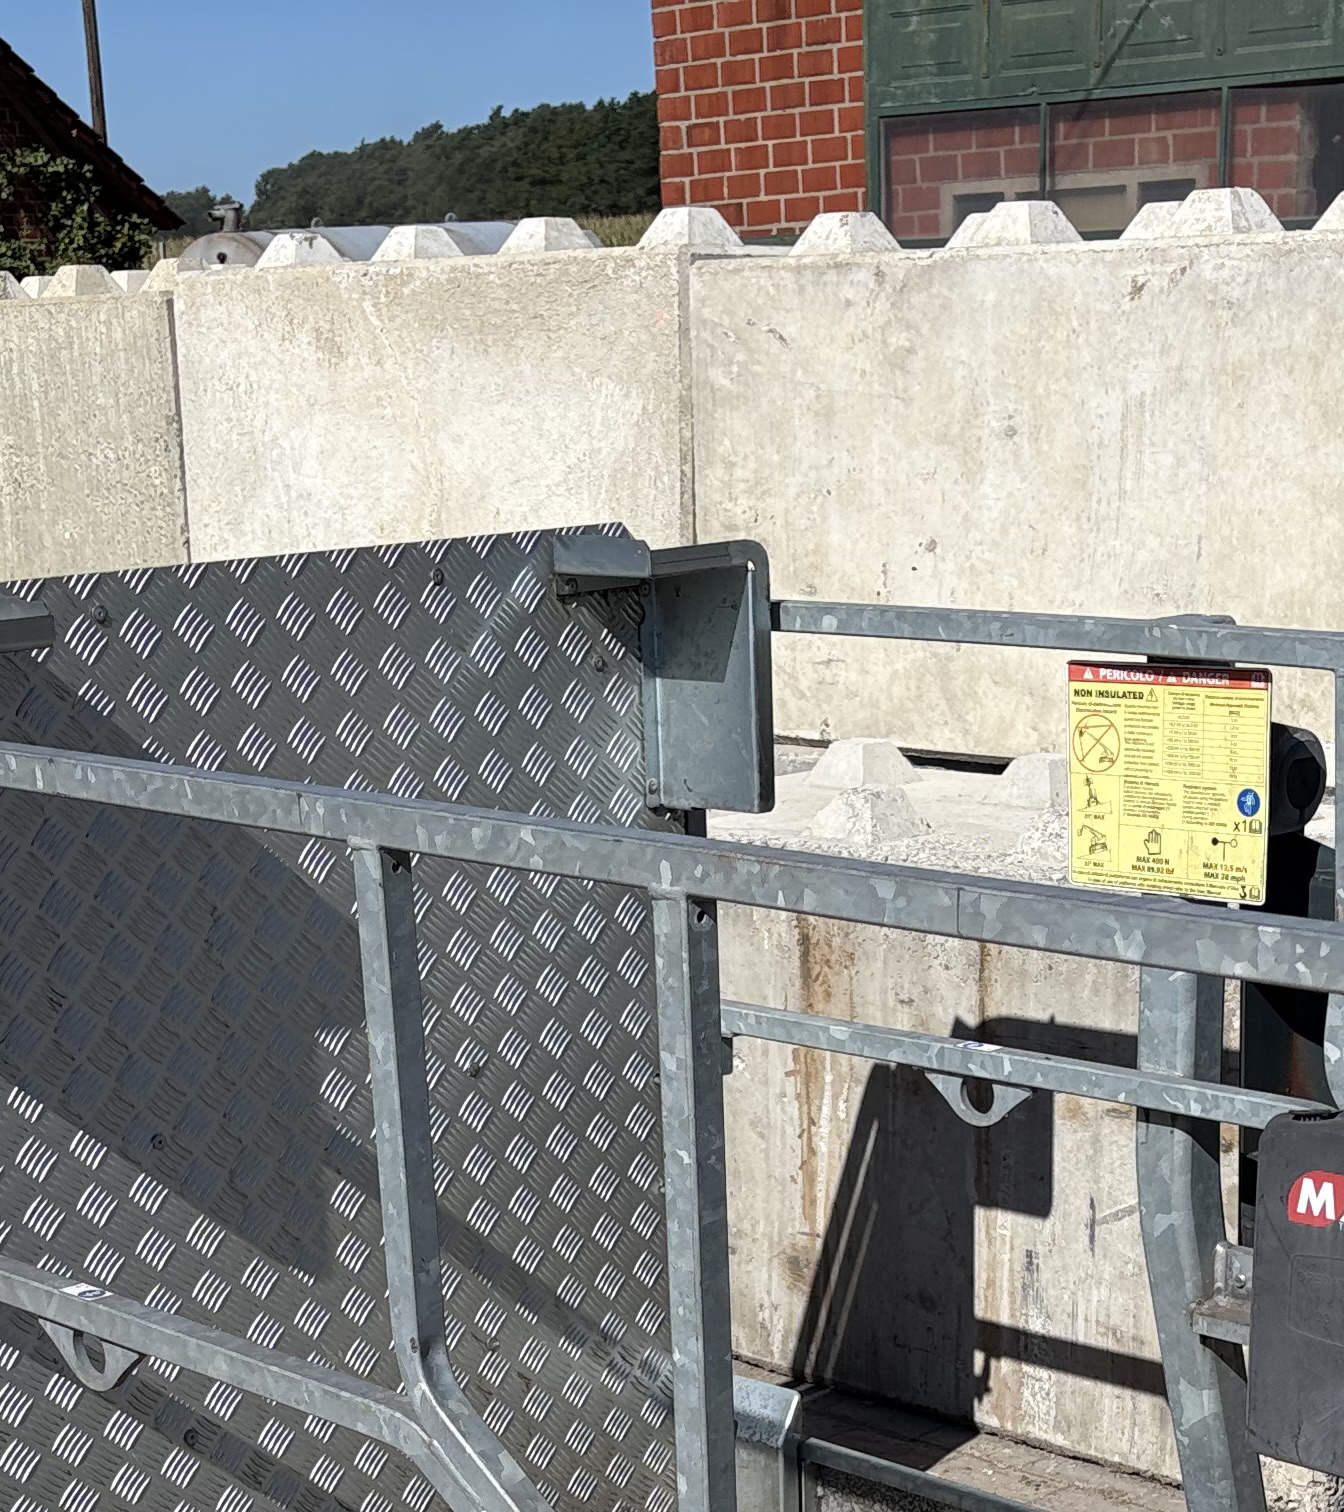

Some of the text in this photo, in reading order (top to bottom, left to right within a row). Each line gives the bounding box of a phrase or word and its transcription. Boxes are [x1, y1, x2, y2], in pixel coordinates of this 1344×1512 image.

[1099, 668, 1155, 681] PERICOLO
[1182, 671, 1230, 685] DANGER
[1074, 688, 1144, 700] NON INSULATED
[1131, 864, 1145, 872] MAX
[1203, 862, 1218, 870] MAX
